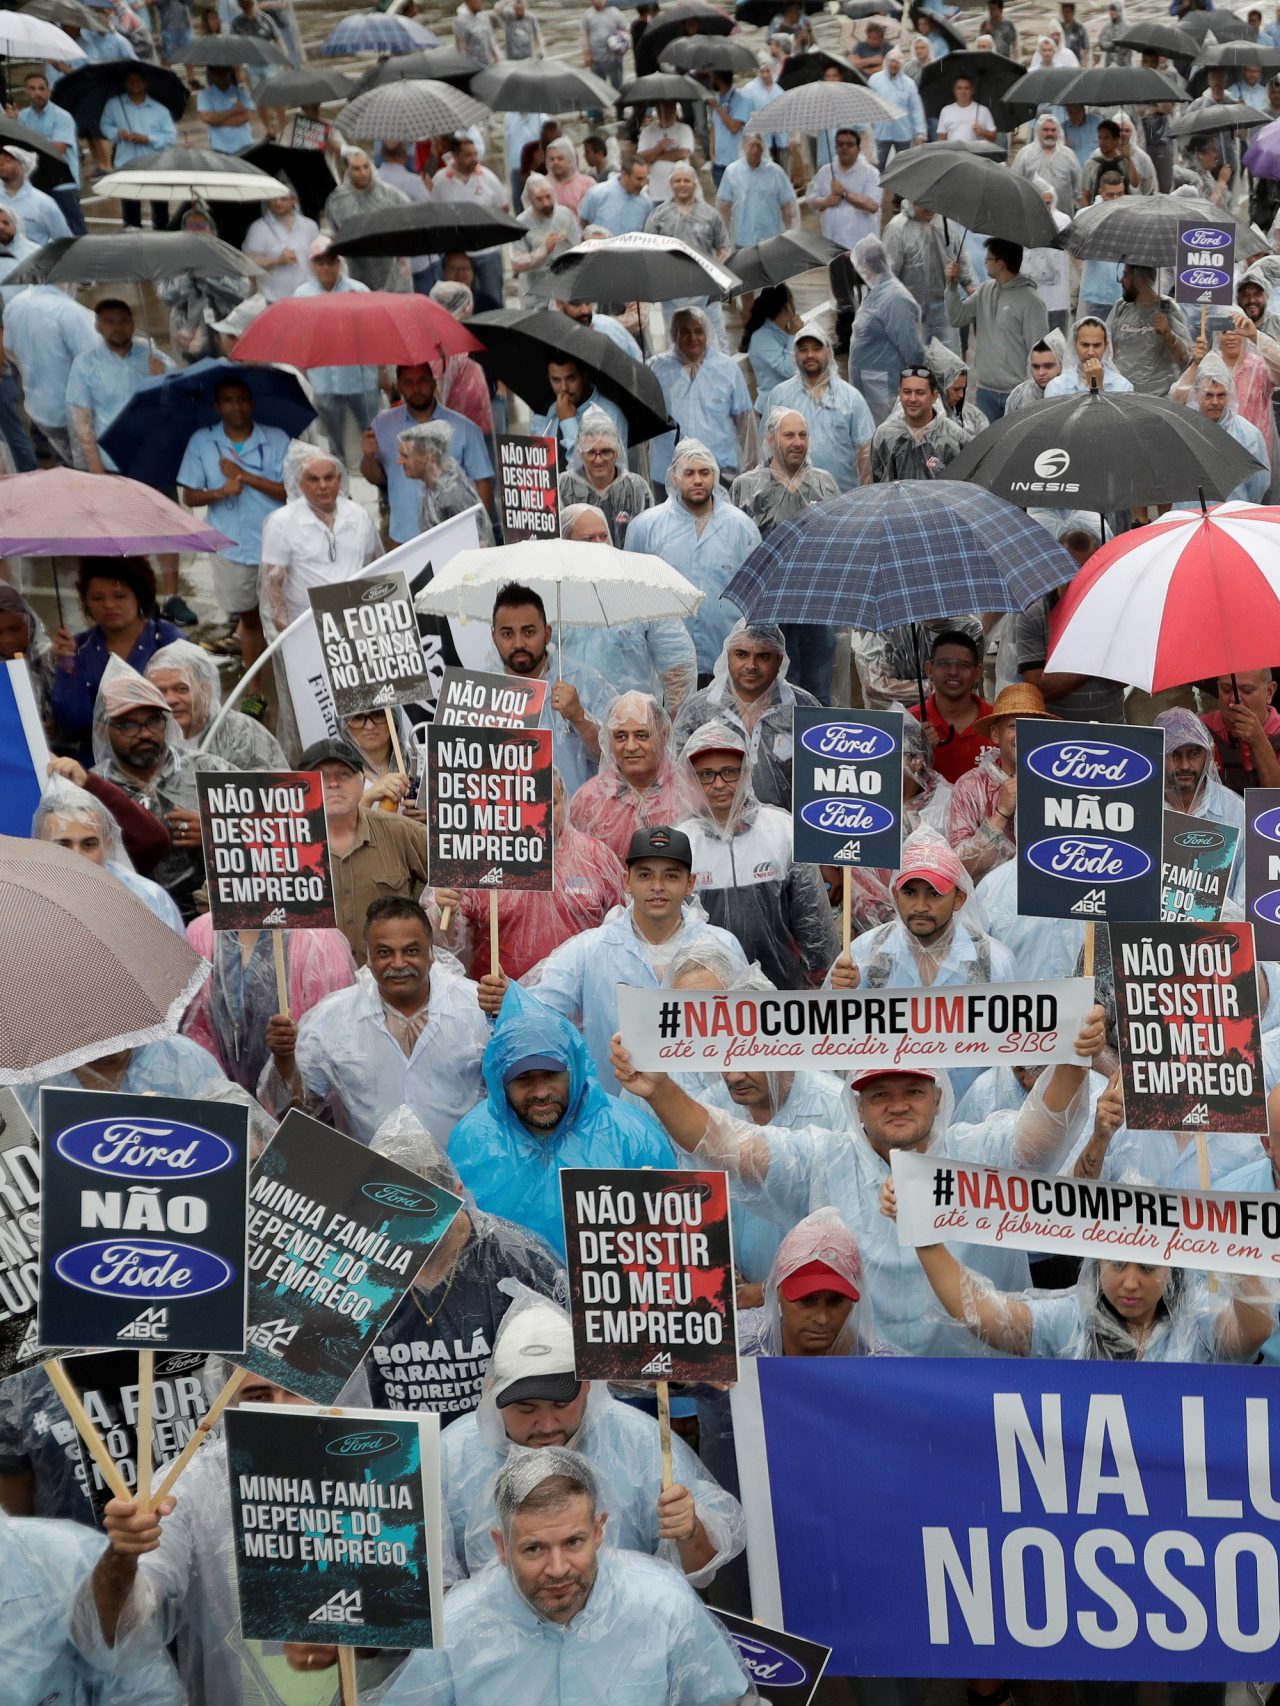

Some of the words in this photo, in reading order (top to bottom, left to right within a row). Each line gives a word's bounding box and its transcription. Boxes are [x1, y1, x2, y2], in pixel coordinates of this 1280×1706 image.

[1191, 231, 1222, 245] Ford
[1187, 250, 1224, 267] NÃO
[501, 442, 523, 465] NÃO
[525, 446, 547, 467] VOU
[503, 466, 550, 489] DESISTIR
[1010, 481, 1080, 493] INESIS
[504, 487, 519, 508] DO
[520, 489, 544, 509] MEU
[505, 508, 556, 532] EMPREGO
[321, 612, 341, 644] A
[343, 599, 412, 639] FORD
[326, 636, 353, 667] SÓ
[355, 630, 418, 662] PENSA
[331, 663, 359, 690] NO
[362, 652, 424, 685] LUCRO
[446, 680, 487, 709] NÃO
[490, 687, 529, 716] VOU
[437, 737, 483, 769] NÃO
[488, 743, 533, 771] VOU
[820, 726, 877, 754] Ford
[813, 764, 882, 795] NÃO
[1052, 745, 1129, 781] Ford
[207, 784, 255, 814] NÃO
[259, 787, 304, 814] VOU
[438, 772, 536, 802] DESISTIR
[211, 817, 312, 843] DESISTIR
[438, 803, 467, 830] DO
[474, 804, 522, 832] MEU
[819, 801, 874, 829] Fode
[1044, 794, 1135, 832] NÃO
[439, 833, 543, 863] EMPREGO
[1182, 833, 1214, 845] Ford
[214, 848, 245, 873] DO
[250, 848, 299, 873] MEU
[1051, 840, 1124, 875] Fode
[218, 877, 324, 903] EMPREGO
[1161, 862, 1220, 896] FAMÍLIA
[1173, 889, 1195, 911] DO
[1121, 937, 1174, 977] NÃO
[1179, 943, 1232, 977] VOU
[658, 994, 1058, 1038] #NÃOCOMPREUMFORD
[1125, 982, 1240, 1017] DESISTIR
[658, 1037, 696, 1058] até
[702, 1047, 719, 1058] a
[722, 1034, 804, 1067] fábrica
[811, 1033, 888, 1056] decidir
[894, 1034, 946, 1064] ficar
[954, 1042, 990, 1054] em
[998, 1031, 1056, 1054] SBC
[1128, 1022, 1162, 1055] DO
[1169, 1023, 1225, 1056] MEU
[1132, 1061, 1253, 1097] EMPREGO
[92, 1124, 200, 1169] Ford
[80, 1185, 208, 1234] NÃO
[375, 1186, 423, 1209] Ford
[575, 1185, 636, 1225] NÃO
[642, 1191, 703, 1226] VOU
[249, 1176, 327, 1231] MINHA
[323, 1212, 414, 1275] FAMÍLIA
[934, 1207, 969, 1230] até
[976, 1218, 991, 1230] a
[994, 1210, 1075, 1241] fábrica
[1082, 1220, 1160, 1248] decidir
[1163, 1228, 1220, 1260] ficar
[1226, 1243, 1263, 1260] em
[578, 1231, 710, 1266] DESISTIR
[90, 1245, 193, 1288] Fode
[331, 1253, 370, 1286] DO
[266, 1261, 373, 1322] EMPREGO
[581, 1270, 621, 1304] DO
[629, 1272, 692, 1305] MEU
[585, 1310, 723, 1345] EMPREGO
[166, 1353, 202, 1372] Ford
[373, 1340, 451, 1365] BORA
[454, 1327, 491, 1361] LÁ
[379, 1358, 491, 1383] GARANTIR
[82, 1390, 112, 1429] A
[119, 1376, 207, 1426] FOR
[384, 1383, 405, 1400] OS
[388, 1398, 404, 1412] DA
[340, 1435, 383, 1453] Ford
[993, 1392, 1149, 1516] NA
[239, 1475, 315, 1504] MINHA
[320, 1479, 413, 1510] FAMÍLIA
[241, 1505, 345, 1535] DEPENDE
[351, 1512, 381, 1536] DO
[244, 1534, 293, 1560] MEU
[299, 1536, 408, 1566] EMPREGO
